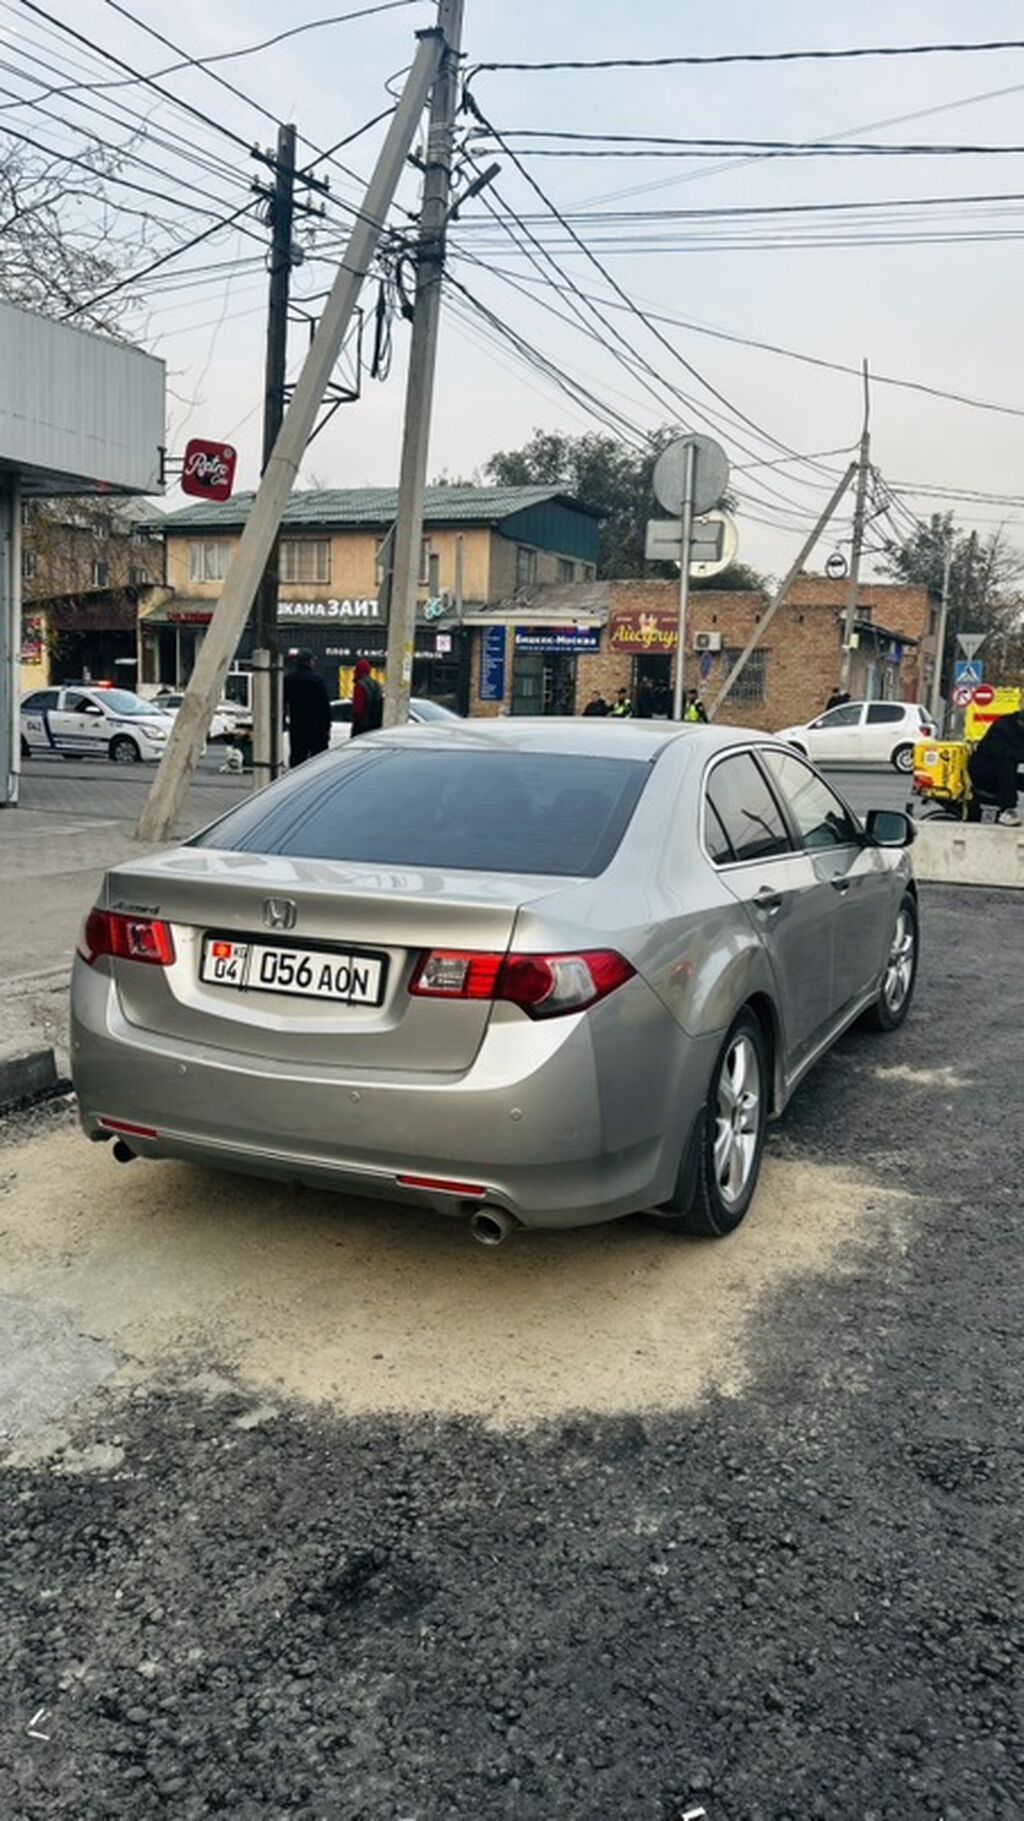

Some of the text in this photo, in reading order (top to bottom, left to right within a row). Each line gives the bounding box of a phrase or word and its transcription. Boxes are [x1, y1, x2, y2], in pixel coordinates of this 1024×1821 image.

[213, 951, 370, 997] 04 056 AON
